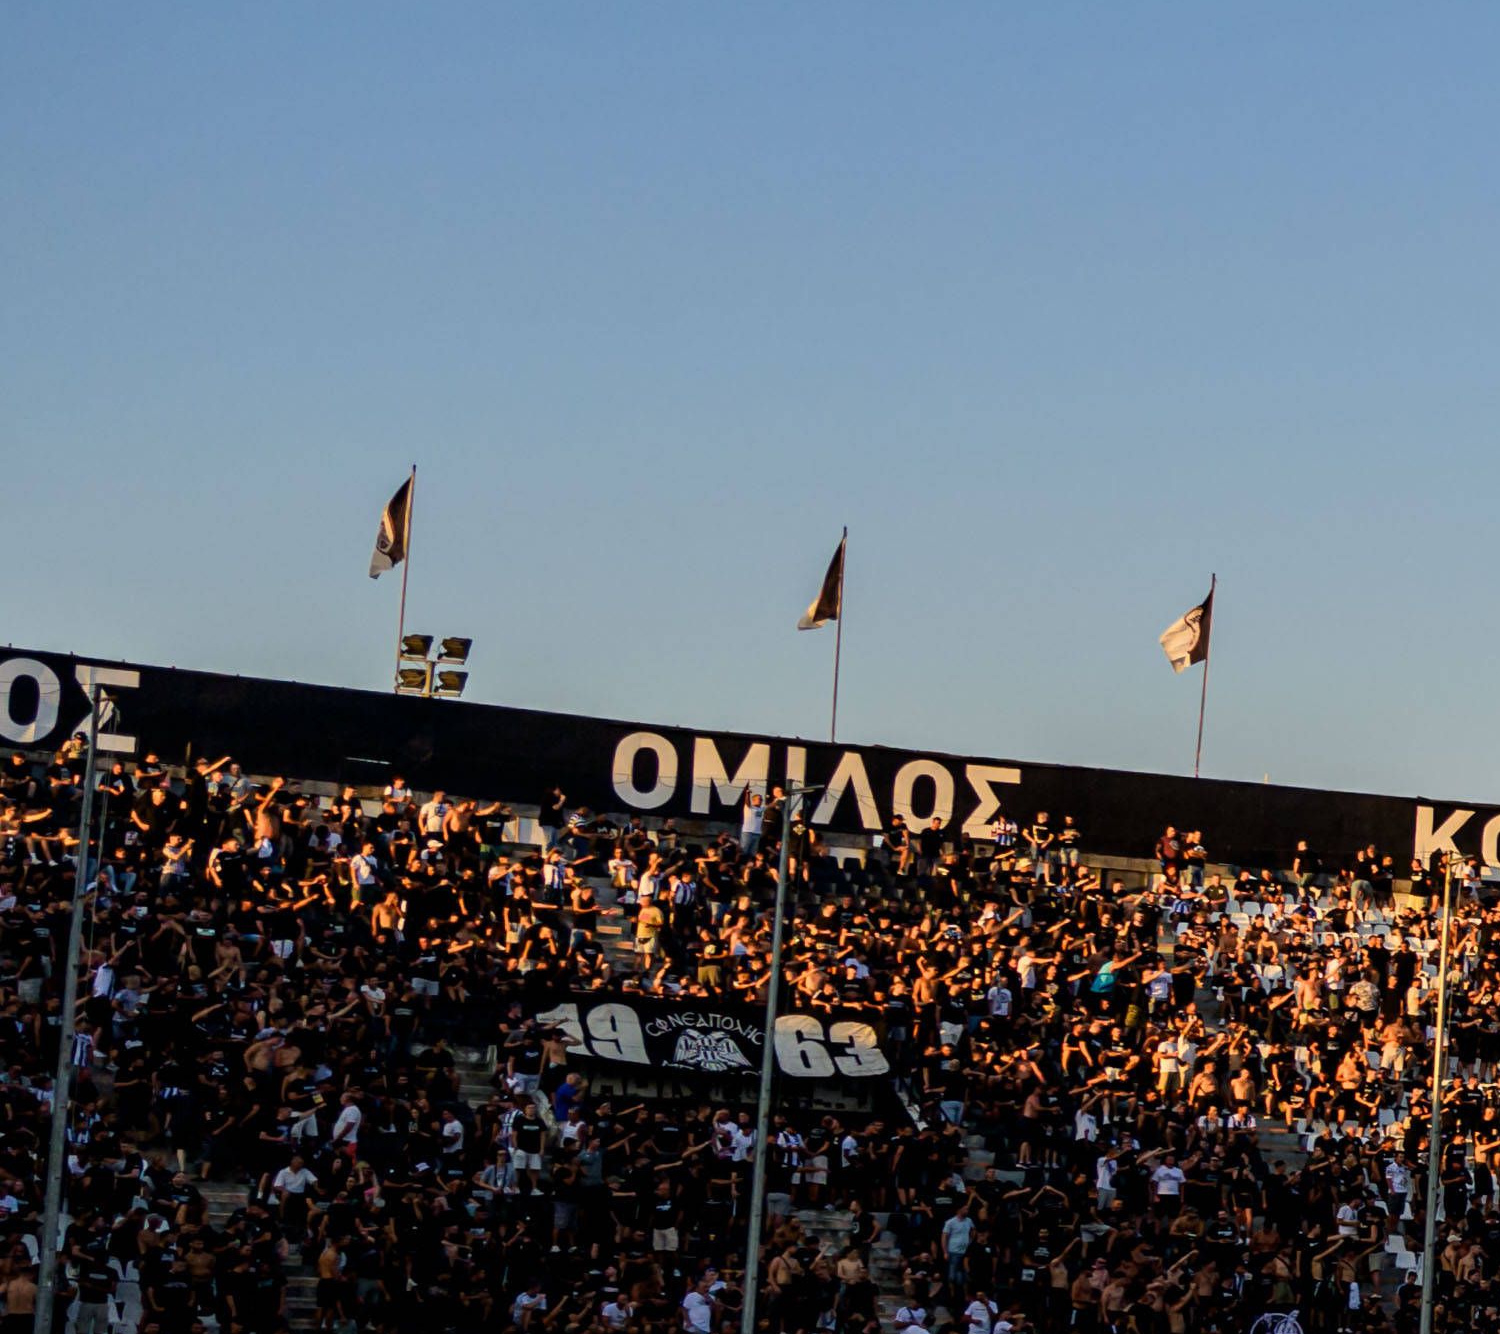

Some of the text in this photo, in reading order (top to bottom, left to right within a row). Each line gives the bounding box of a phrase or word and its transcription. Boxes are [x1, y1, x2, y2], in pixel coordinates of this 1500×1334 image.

[611, 730, 1022, 841] ΟΜΙΛΟΣ
[534, 1002, 652, 1066] 19
[774, 1013, 891, 1078] 63
